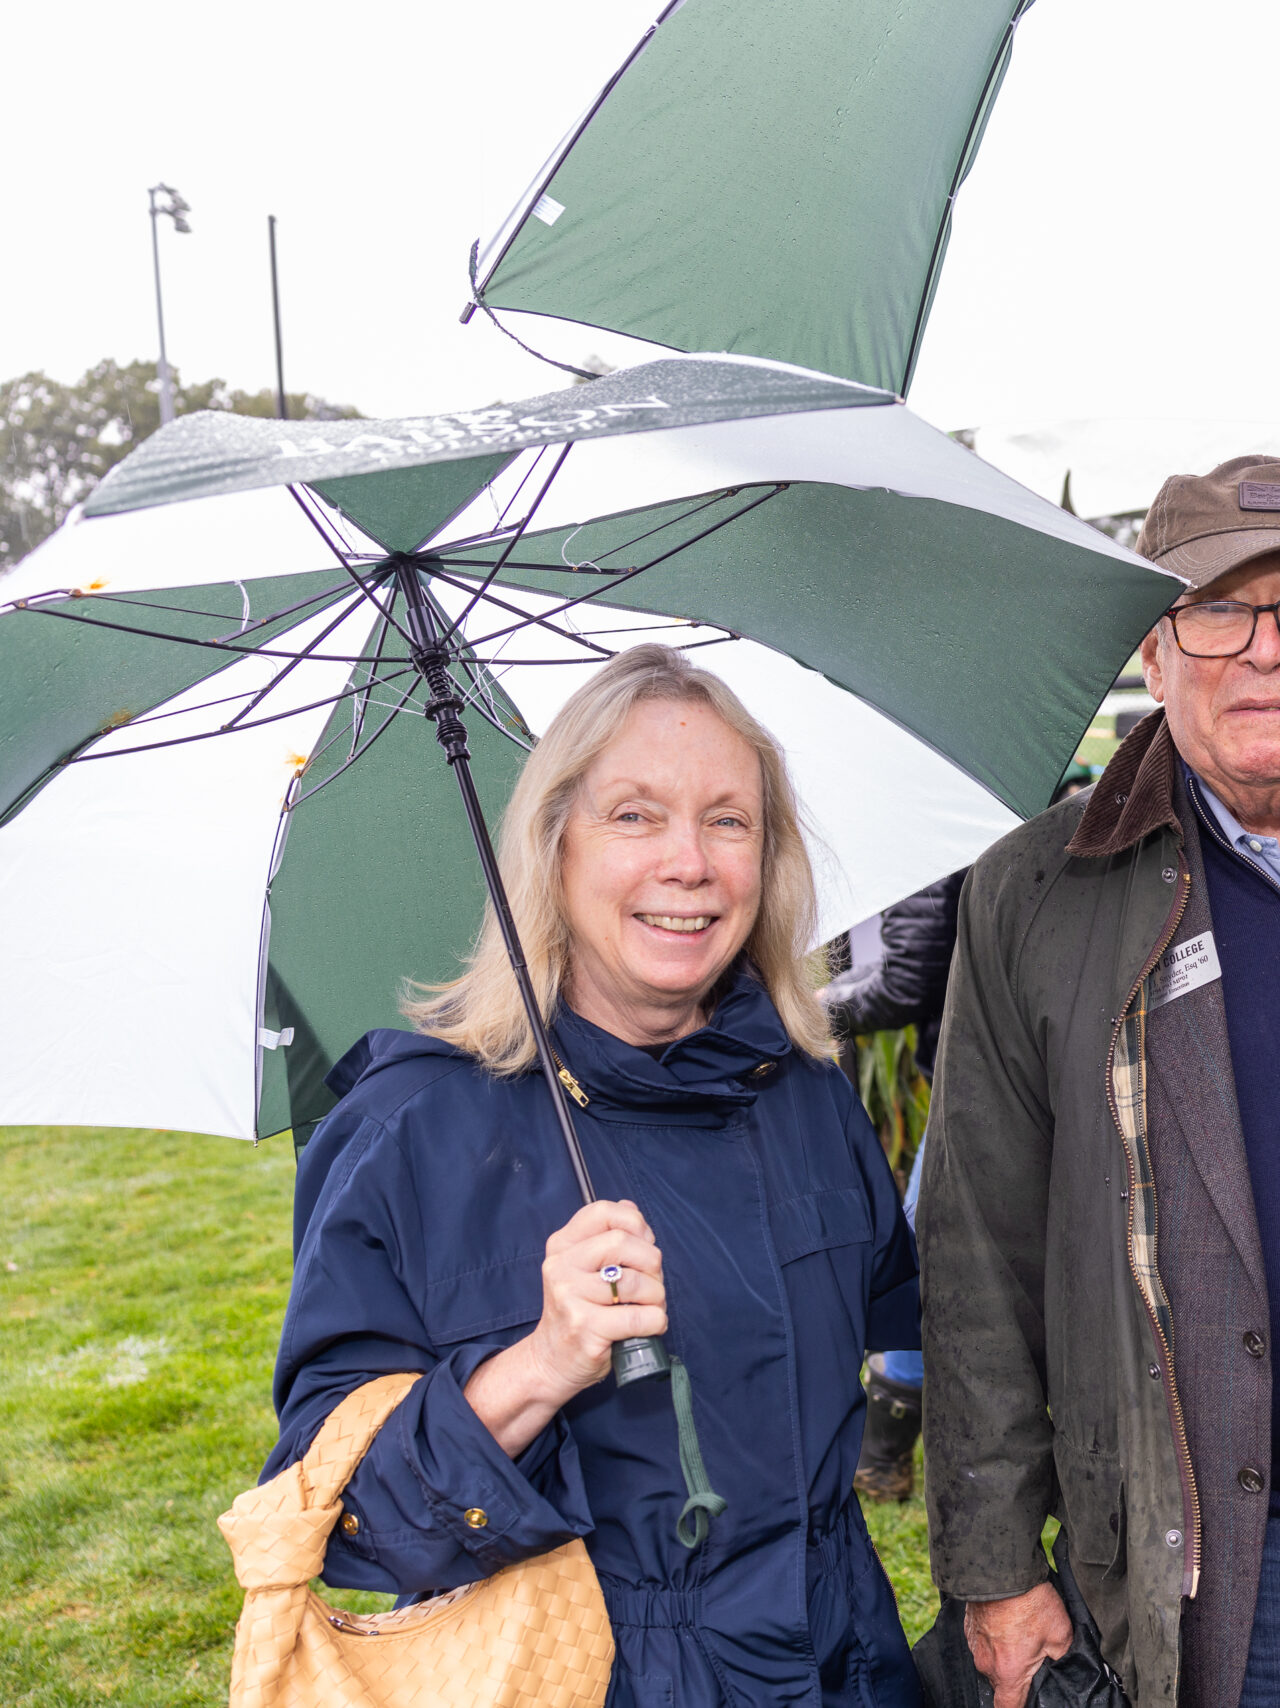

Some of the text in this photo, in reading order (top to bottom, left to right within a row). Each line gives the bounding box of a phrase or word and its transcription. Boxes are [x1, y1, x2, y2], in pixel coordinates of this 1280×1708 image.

[1163, 940, 1205, 968] COLLEGE
[1184, 961, 1198, 972] Esq
[1197, 955, 1209, 965] '60
